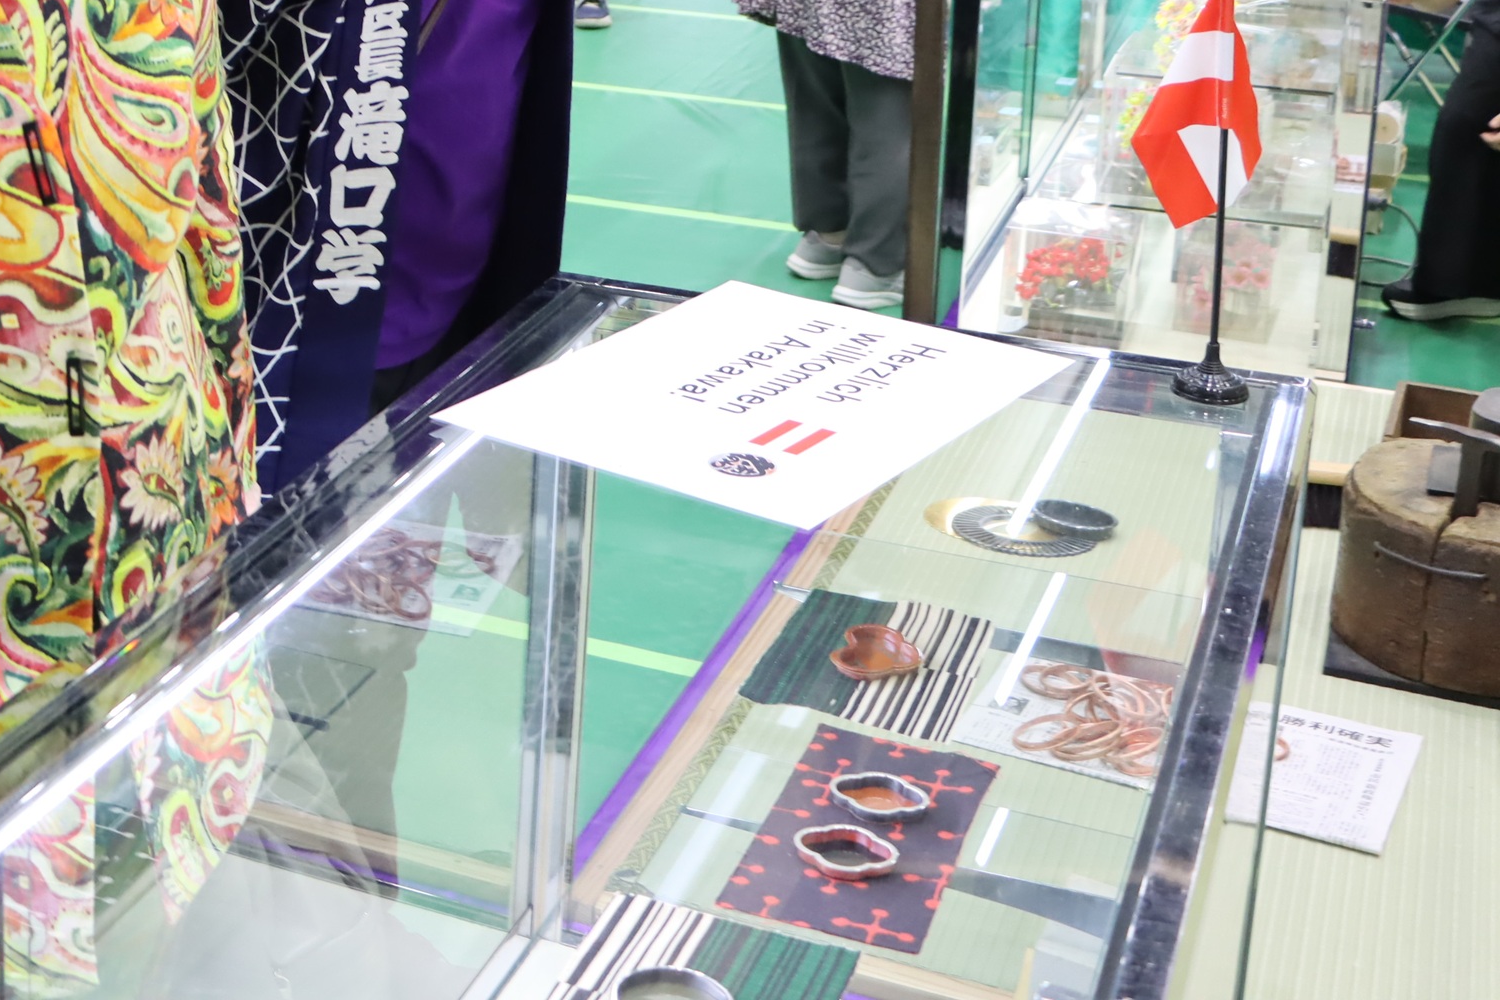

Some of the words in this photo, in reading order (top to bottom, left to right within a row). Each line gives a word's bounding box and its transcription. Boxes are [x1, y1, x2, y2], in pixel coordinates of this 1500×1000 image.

[798, 319, 848, 334] in
[670, 335, 811, 403] Arakawa!
[718, 332, 886, 414] willkommen
[816, 343, 947, 403] Herzlich
